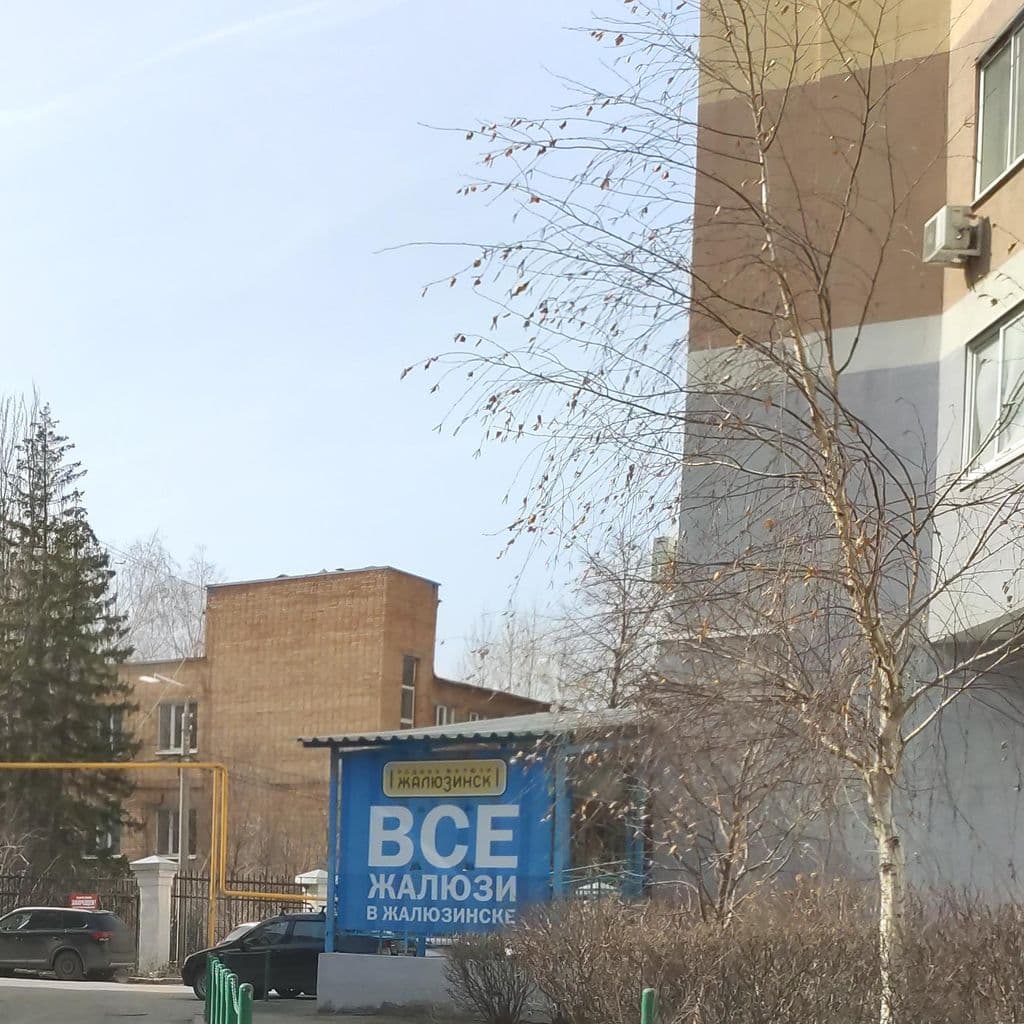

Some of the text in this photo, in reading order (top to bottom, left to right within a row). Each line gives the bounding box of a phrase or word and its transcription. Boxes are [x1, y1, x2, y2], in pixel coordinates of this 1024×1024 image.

[397, 775, 492, 792] ЖАЛЮЗИНСК
[368, 804, 520, 868] ВСЕ
[367, 873, 517, 902] ЖАЛЮЗИ
[367, 905, 516, 925] В ЖАЛЮЗИНСКЕ
